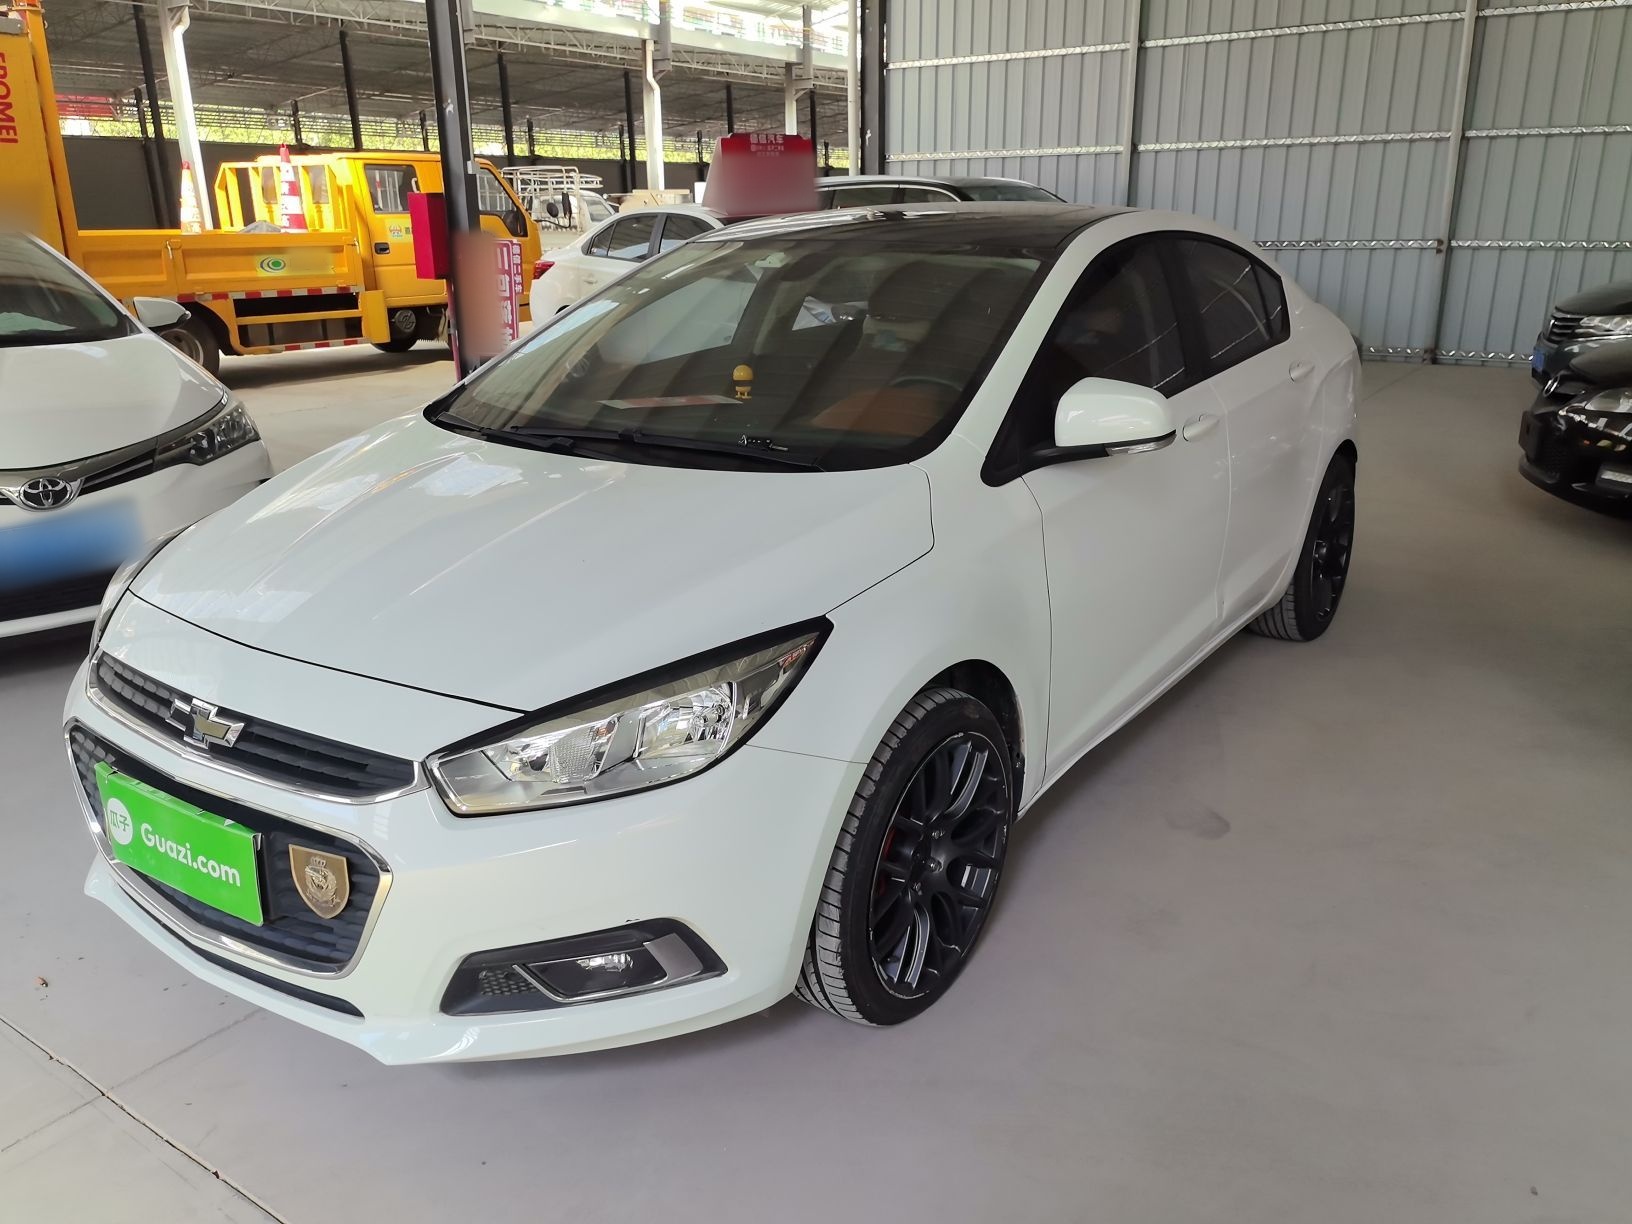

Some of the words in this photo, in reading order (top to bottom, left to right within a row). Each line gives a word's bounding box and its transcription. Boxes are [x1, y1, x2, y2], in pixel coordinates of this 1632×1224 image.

[0, 52, 19, 144] OMEI
[109, 809, 130, 832] 瓜子
[140, 822, 241, 887] Guazi.com
